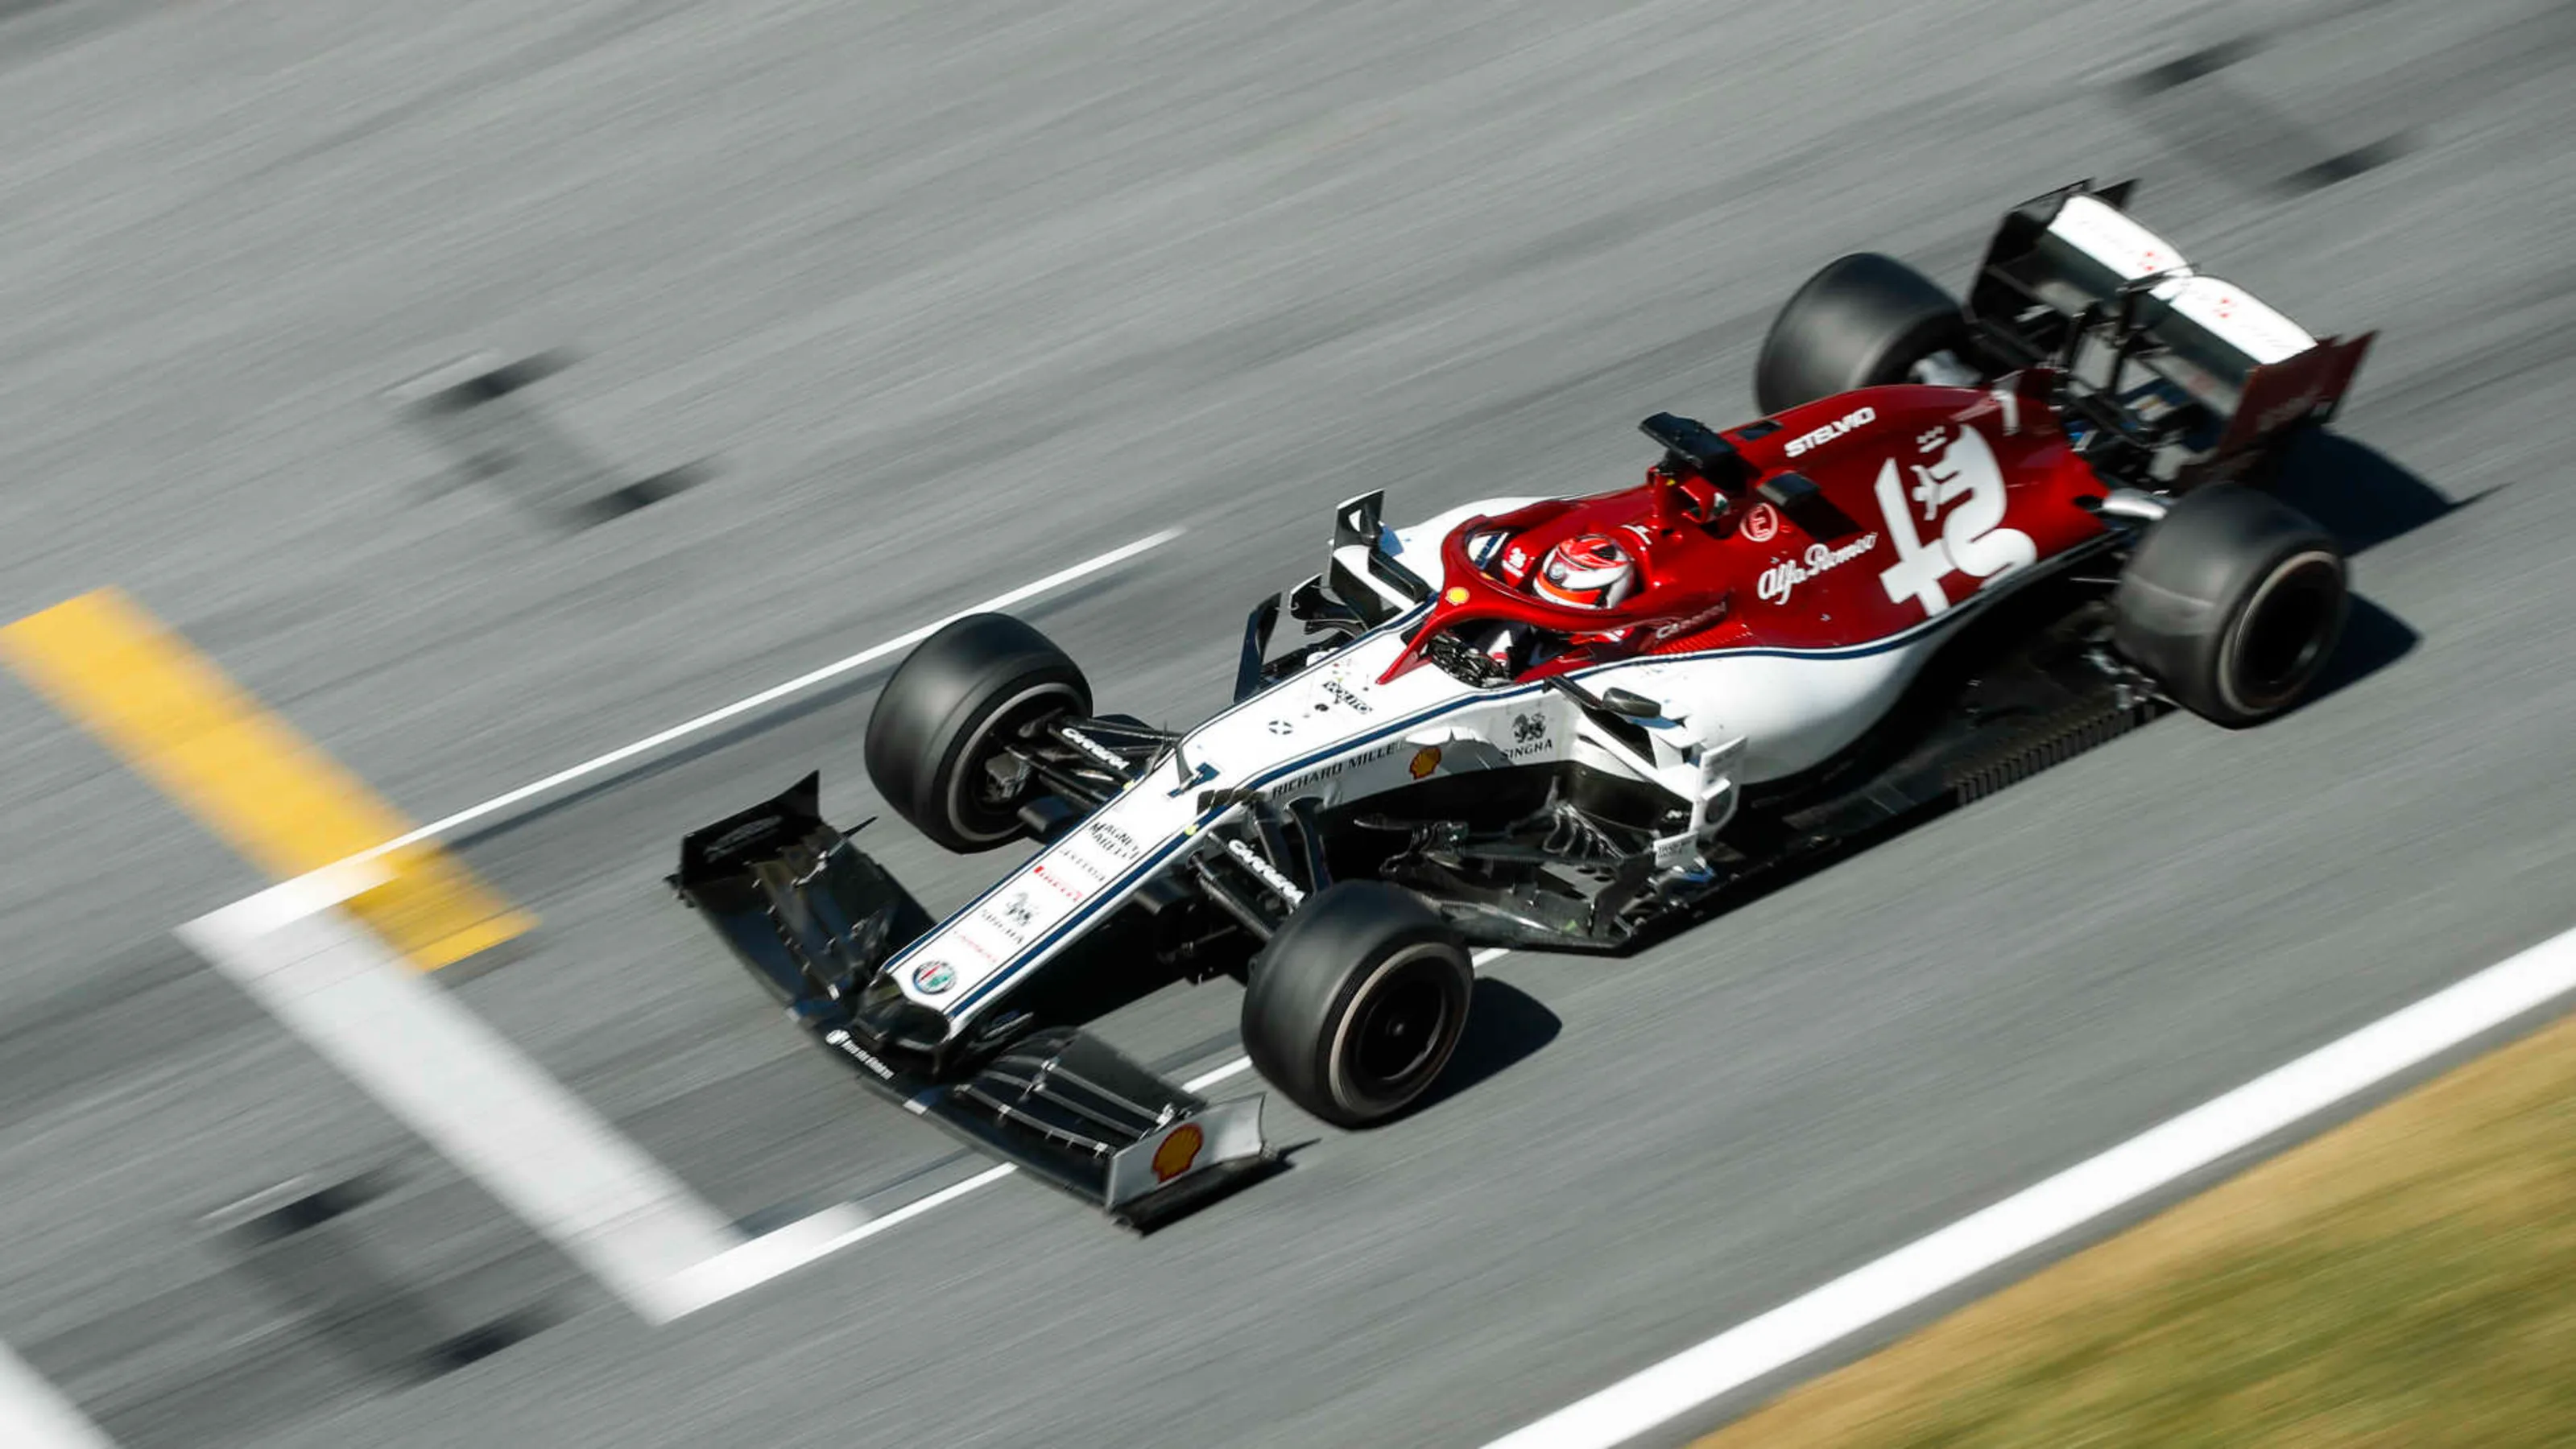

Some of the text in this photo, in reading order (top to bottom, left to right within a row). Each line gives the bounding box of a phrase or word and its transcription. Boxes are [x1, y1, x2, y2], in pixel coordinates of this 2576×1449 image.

[1784, 407, 1876, 458] STELVIO
[1758, 532, 1879, 605] Alfa Romeo
[1272, 741, 1397, 799] RICHARD MILLE
